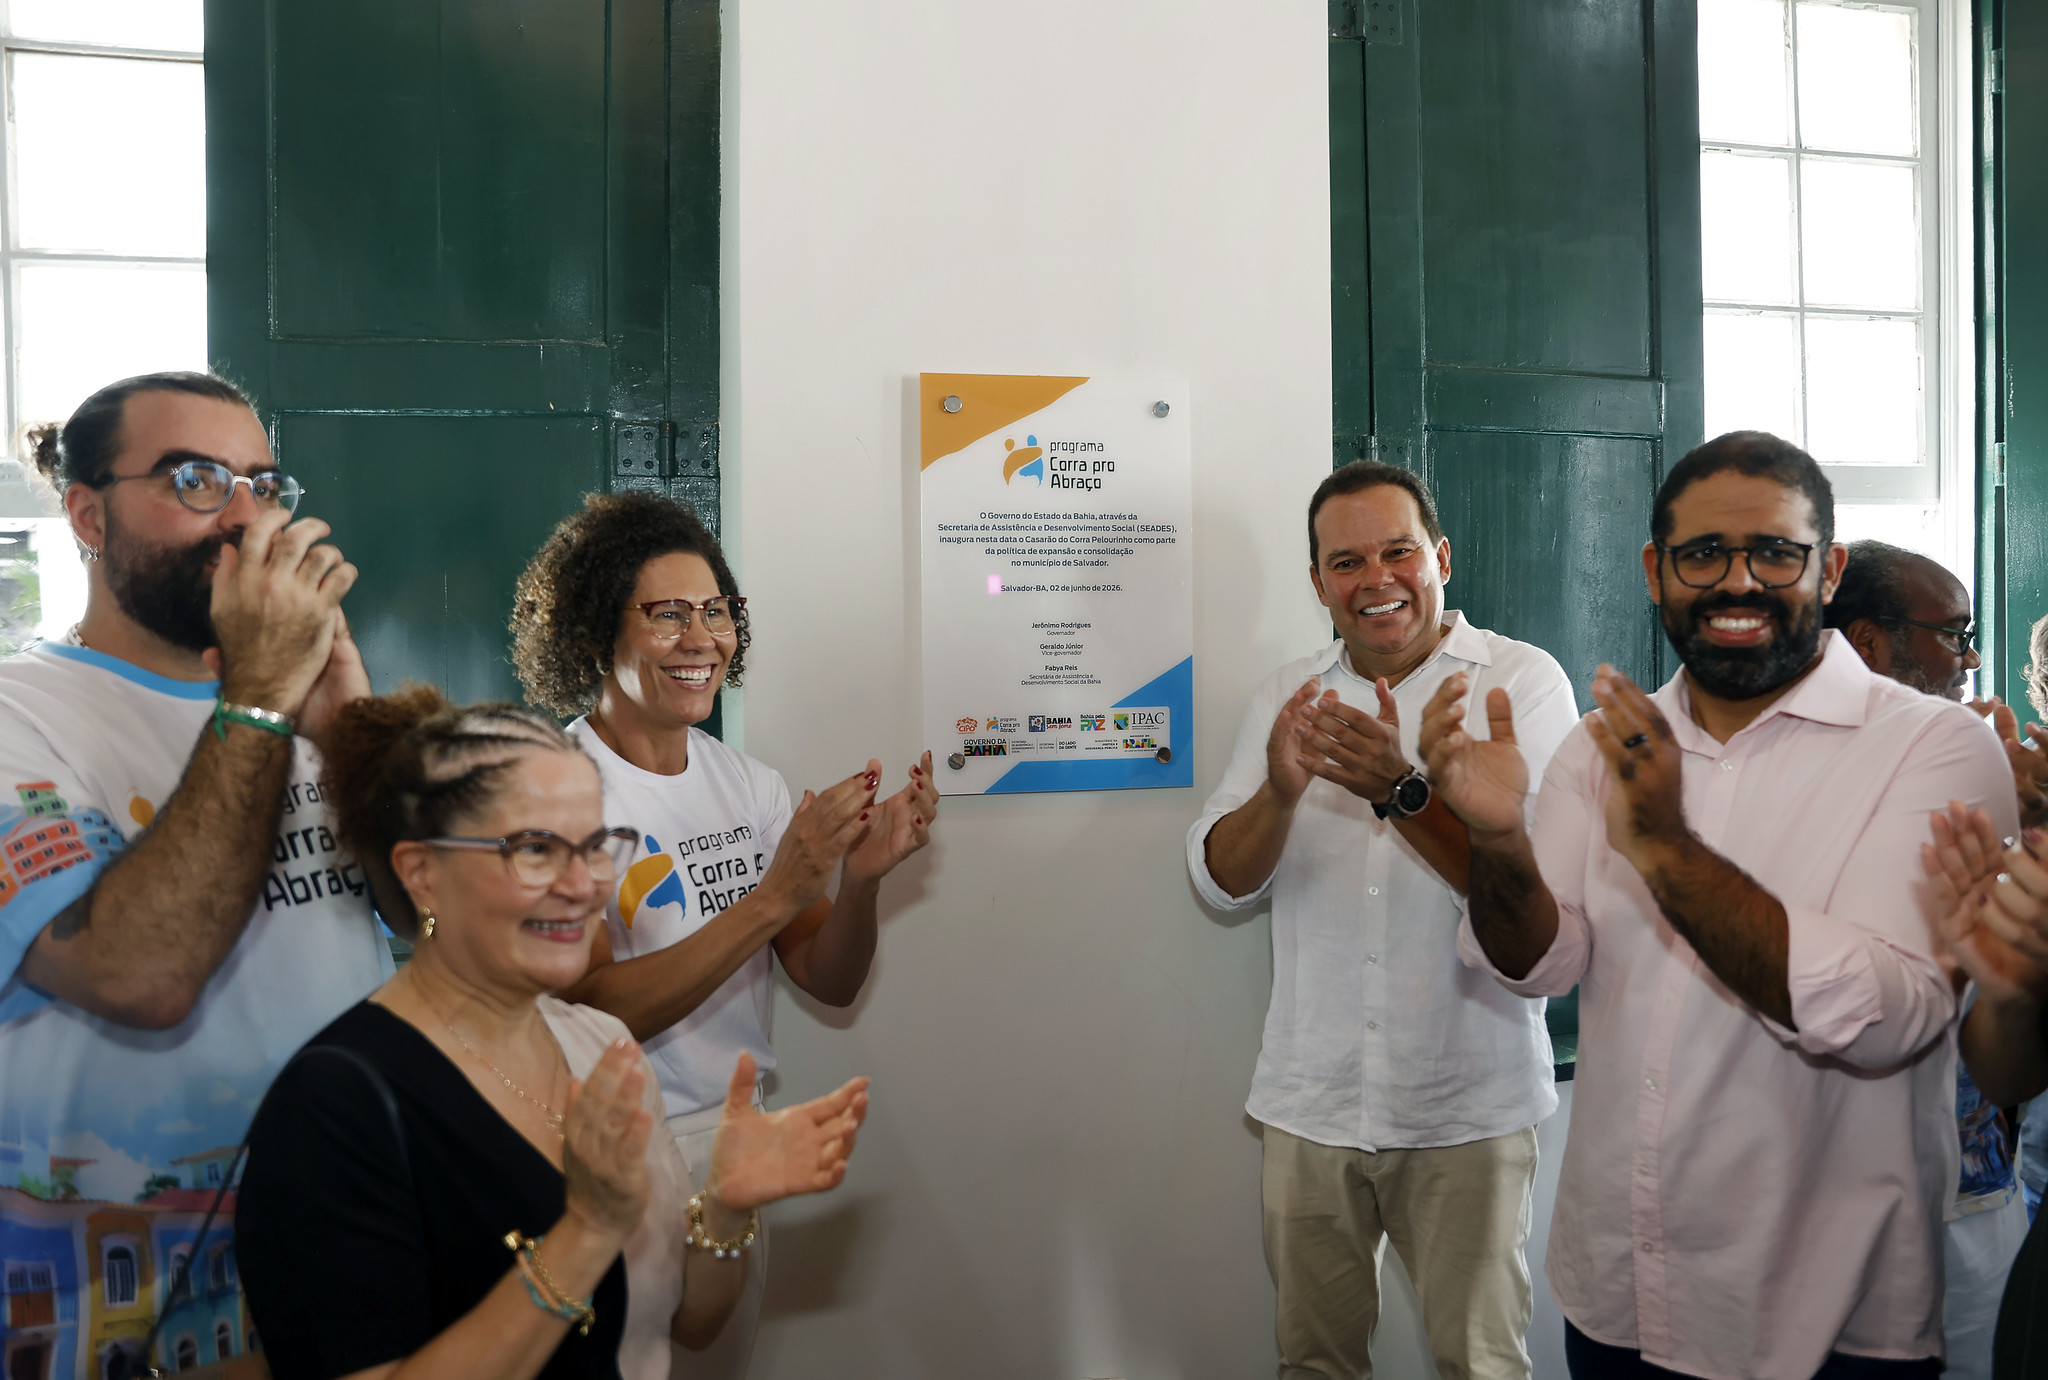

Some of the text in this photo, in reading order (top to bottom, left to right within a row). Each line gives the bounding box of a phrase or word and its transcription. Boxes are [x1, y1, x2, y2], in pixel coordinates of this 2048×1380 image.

[1050, 442, 1104, 454] programa
[1050, 456, 1115, 474] Corra pro
[1050, 474, 1102, 492] Abraço
[939, 536, 974, 544] inaugura
[996, 547, 1026, 556] política
[1083, 548, 1134, 556] consolidação
[1022, 559, 1061, 568] município
[1132, 712, 1164, 724] IPAC
[1081, 719, 1106, 731] PAZ
[1123, 738, 1157, 749] BRASIL
[964, 745, 1007, 756] BAHIA
[274, 826, 336, 862] orra
[687, 858, 747, 886] Corra
[264, 862, 366, 911] Abraç
